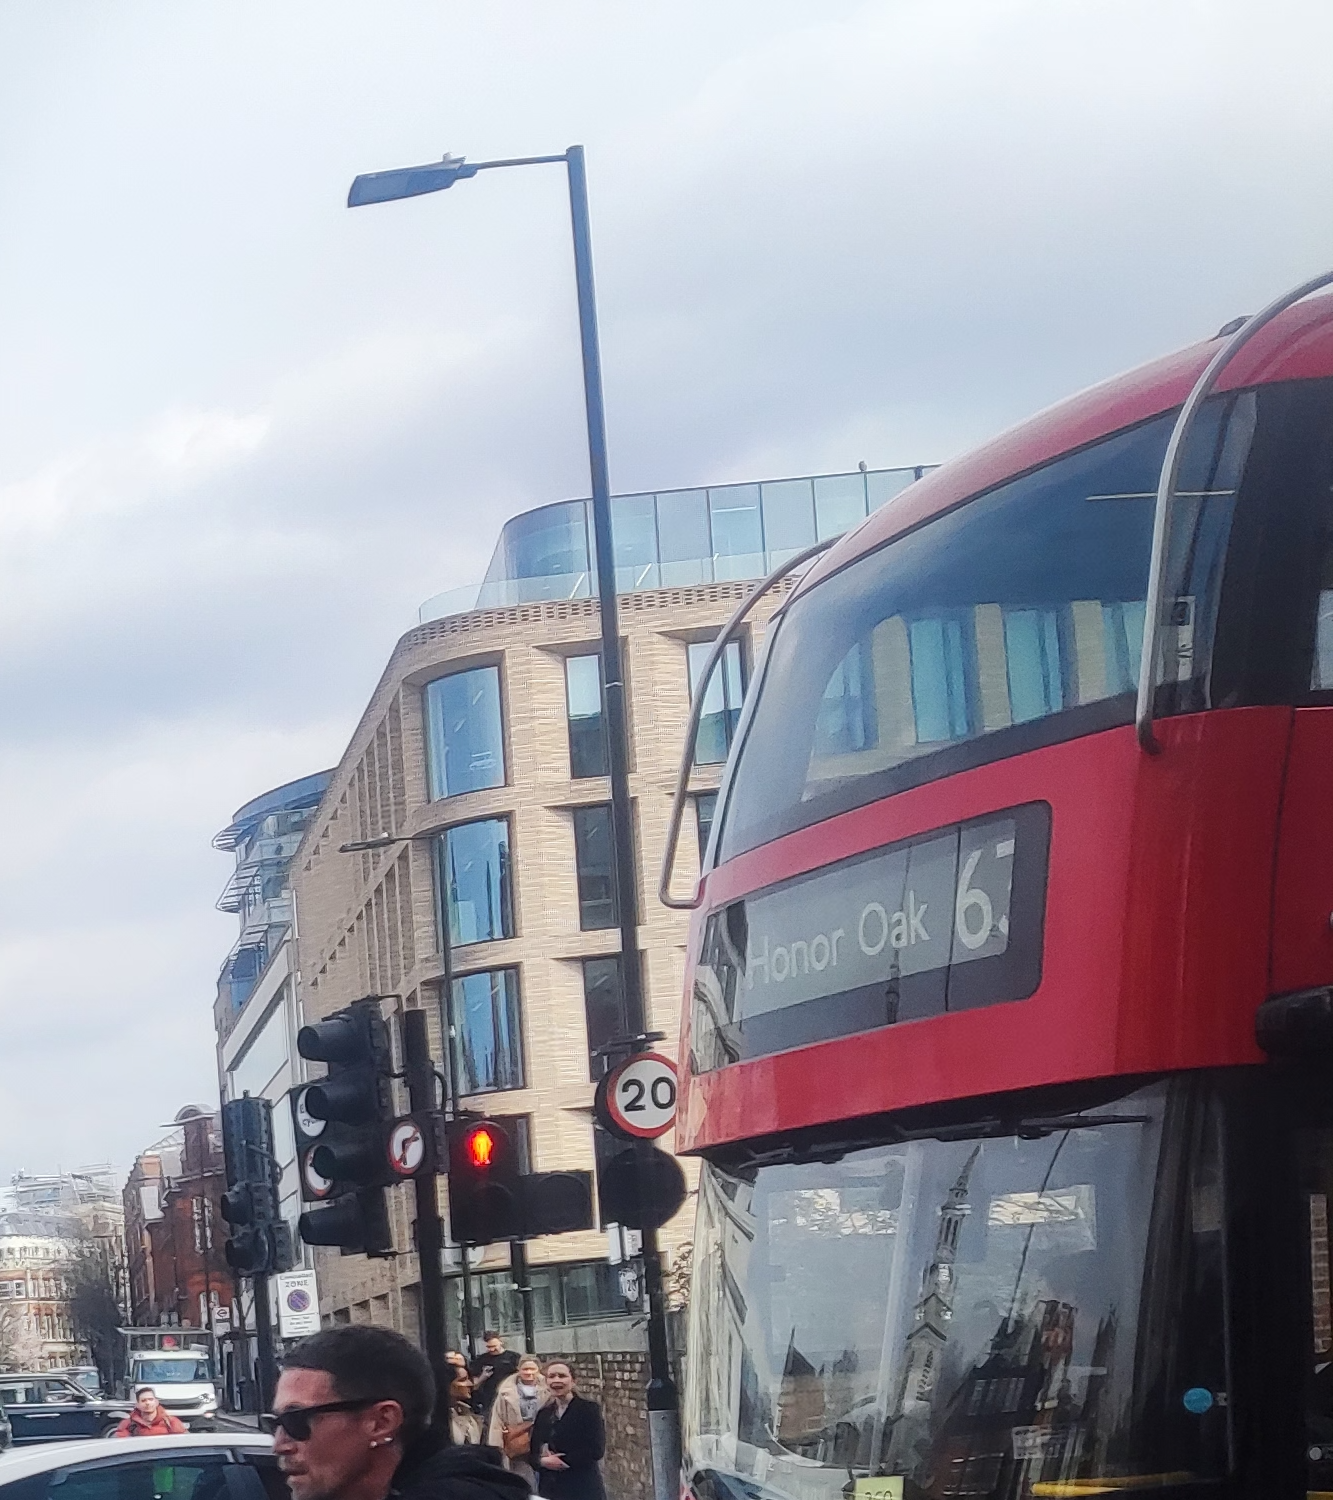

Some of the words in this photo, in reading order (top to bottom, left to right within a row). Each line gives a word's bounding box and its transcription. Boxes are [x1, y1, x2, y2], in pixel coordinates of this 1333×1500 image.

[745, 928, 845, 990] Honor
[858, 890, 932, 956] Oak
[621, 1076, 677, 1113] 20
